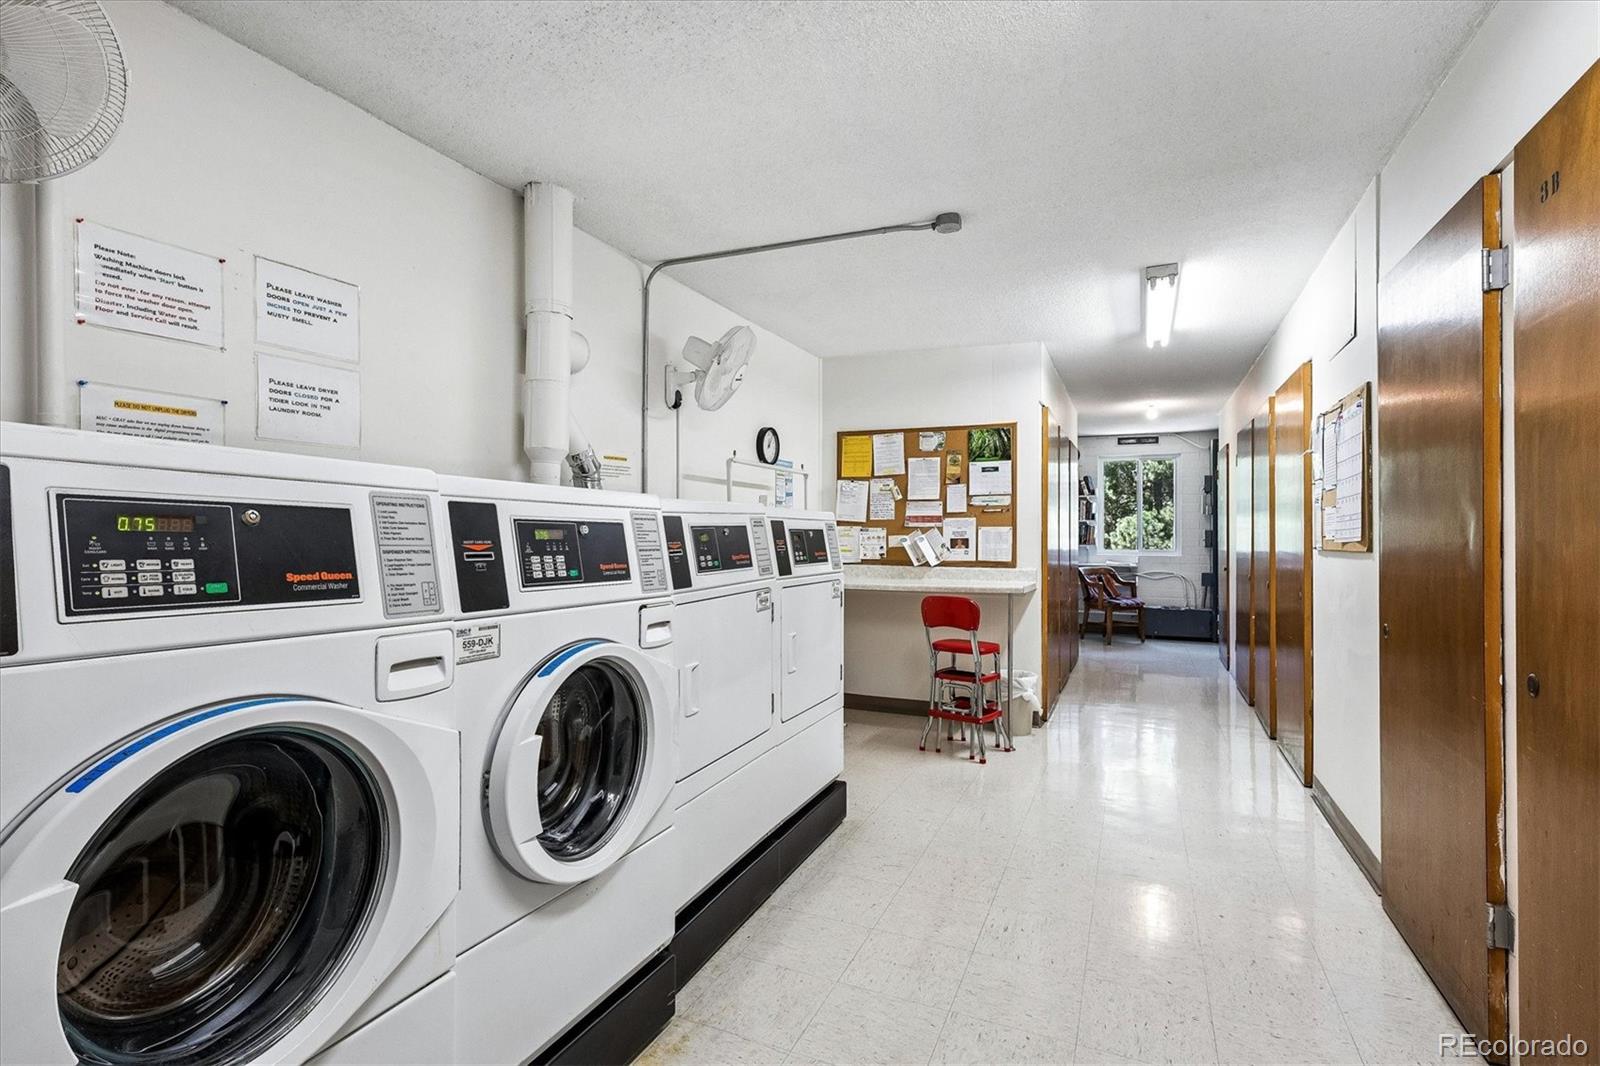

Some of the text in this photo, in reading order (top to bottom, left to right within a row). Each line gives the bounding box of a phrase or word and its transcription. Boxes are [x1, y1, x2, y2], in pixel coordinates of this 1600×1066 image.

[94, 243, 136, 259] Please Note:
[94, 253, 186, 282] Washing Machine doors lock
[102, 272, 122, 280] essed.
[138, 272, 156, 282] when
[177, 282, 198, 292] button
[105, 290, 122, 298] force
[137, 298, 159, 306] washer
[164, 296, 187, 305] reason,
[188, 301, 211, 311] attempt
[266, 292, 290, 303] DOORS
[292, 299, 310, 308] OPEN
[294, 291, 314, 301] LEAVE
[317, 297, 342, 308] WASHER
[95, 296, 125, 308] Disaster,
[126, 303, 156, 316] Including
[158, 310, 177, 318] Water
[266, 302, 292, 312] INCHES
[304, 310, 332, 321] PREVENT
[95, 304, 114, 314] Floor
[131, 312, 154, 322] Service
[182, 323, 200, 332] result.
[266, 310, 314, 326] MUSTY SMELL.
[268, 388, 292, 396] DOORS
[294, 392, 319, 401] CLOSED
[296, 384, 316, 392] LEAVE
[318, 388, 339, 396] DRYER
[114, 401, 132, 410] PLEASE
[132, 402, 141, 410] DO
[269, 406, 300, 415] LAUNDRY
[118, 516, 156, 532] 0.75
[286, 572, 352, 582] Speed Queen
[328, 582, 348, 590] Washer
[462, 636, 494, 650] 559-DJK
